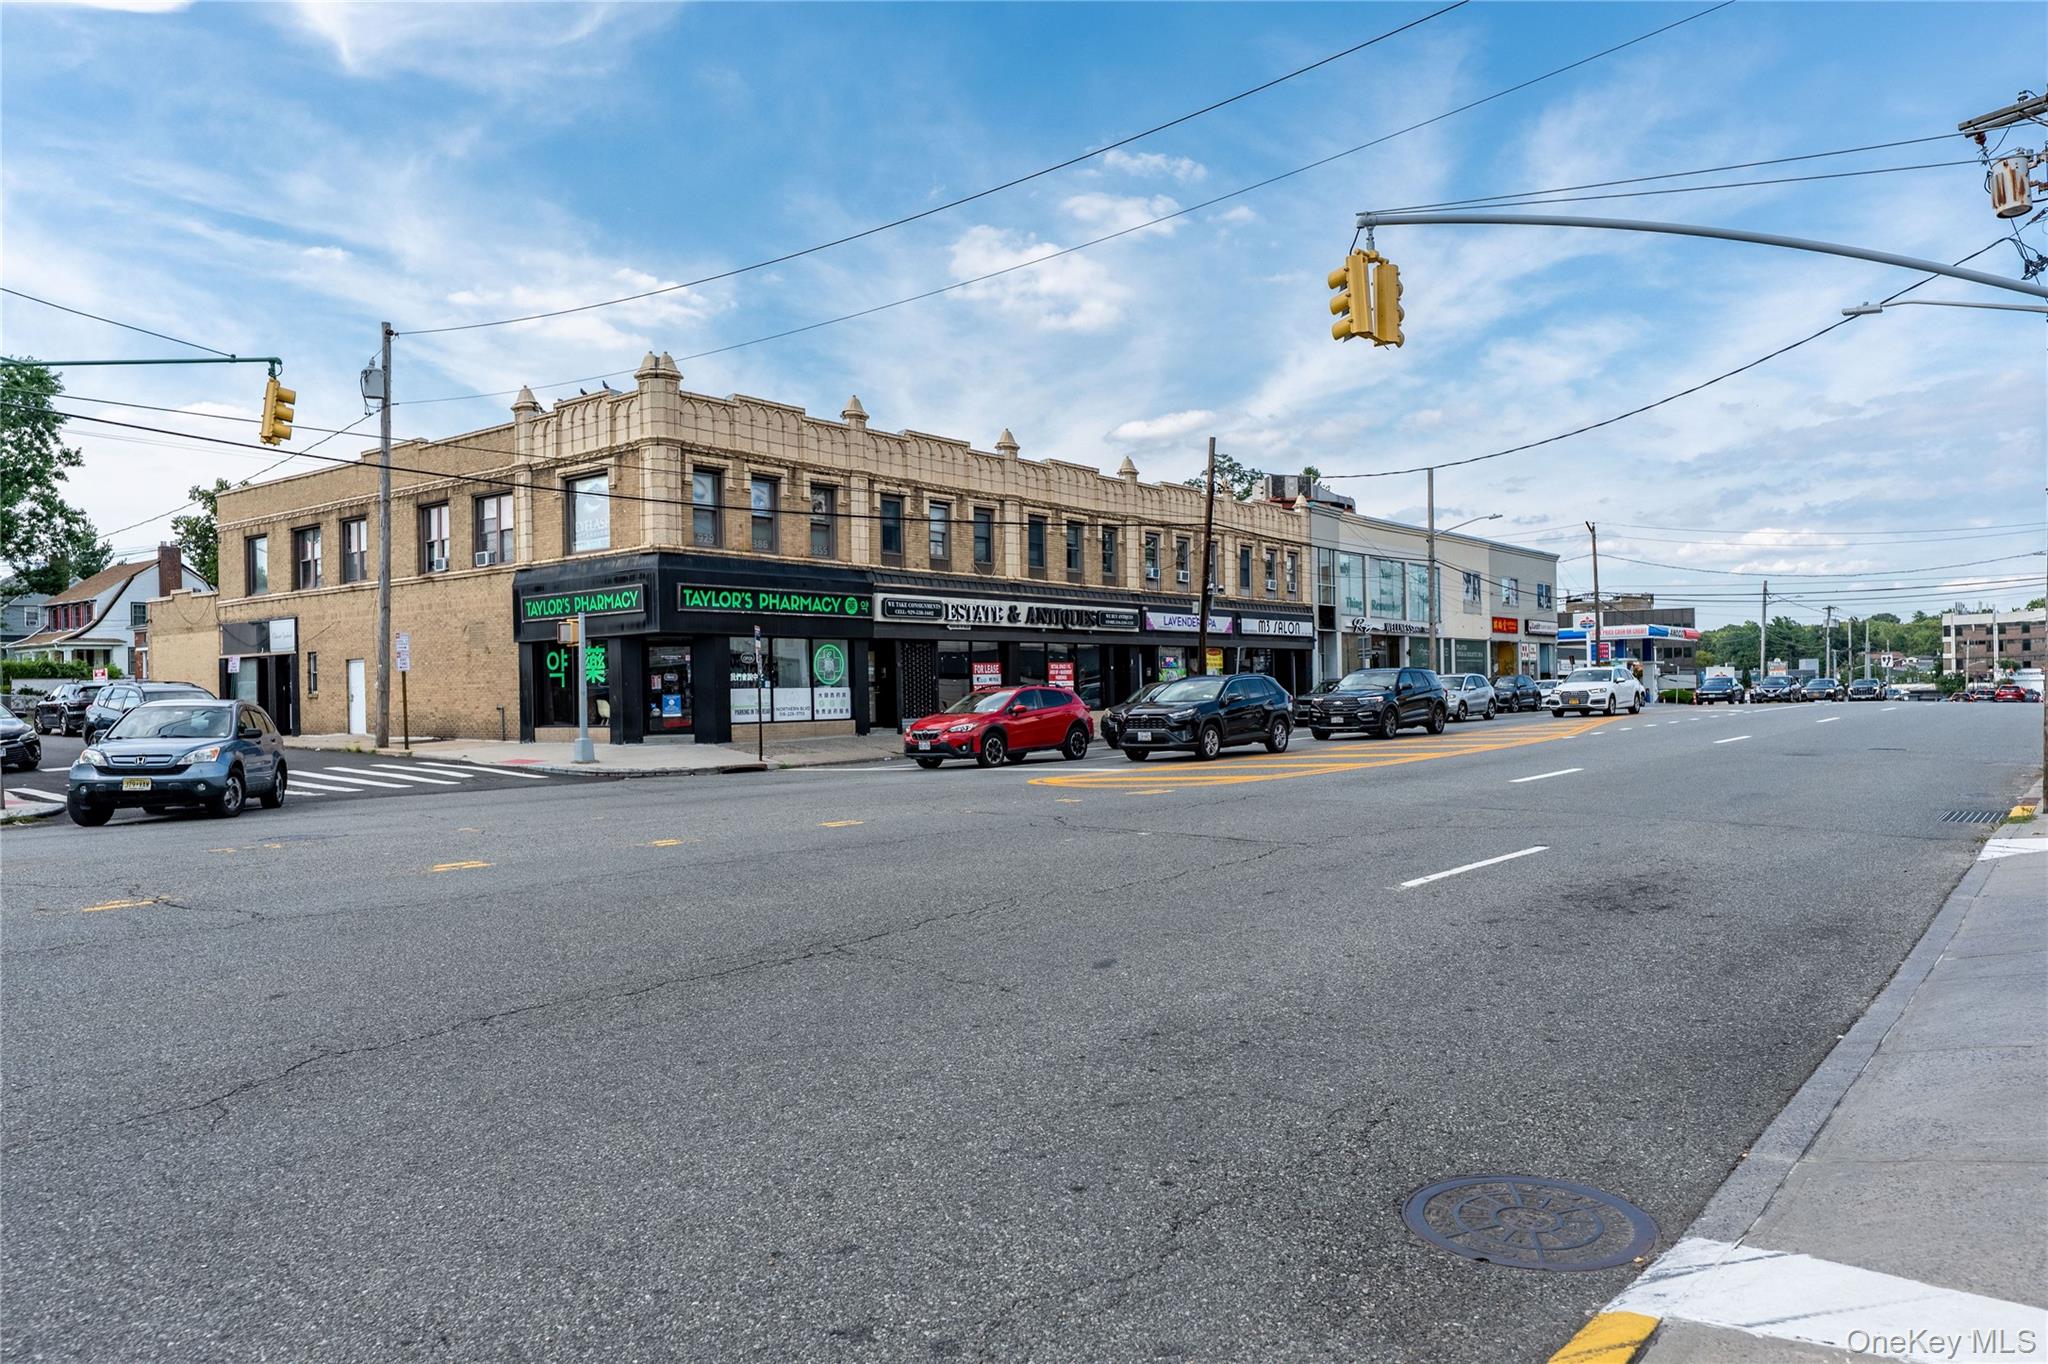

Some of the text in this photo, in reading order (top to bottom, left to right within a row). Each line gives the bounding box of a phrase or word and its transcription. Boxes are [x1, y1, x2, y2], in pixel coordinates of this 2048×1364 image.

[525, 590, 639, 617] TAYLOR'S PHARMACY
[683, 589, 842, 613] TAYLOR'S PHARMACY
[944, 603, 1098, 629] ESTATE & ANTIQUES
[1163, 615, 1200, 628] LAVENDER
[1258, 619, 1301, 635] M3 SALON
[546, 648, 569, 689] 약
[974, 664, 1000, 674] FOR LEASE
